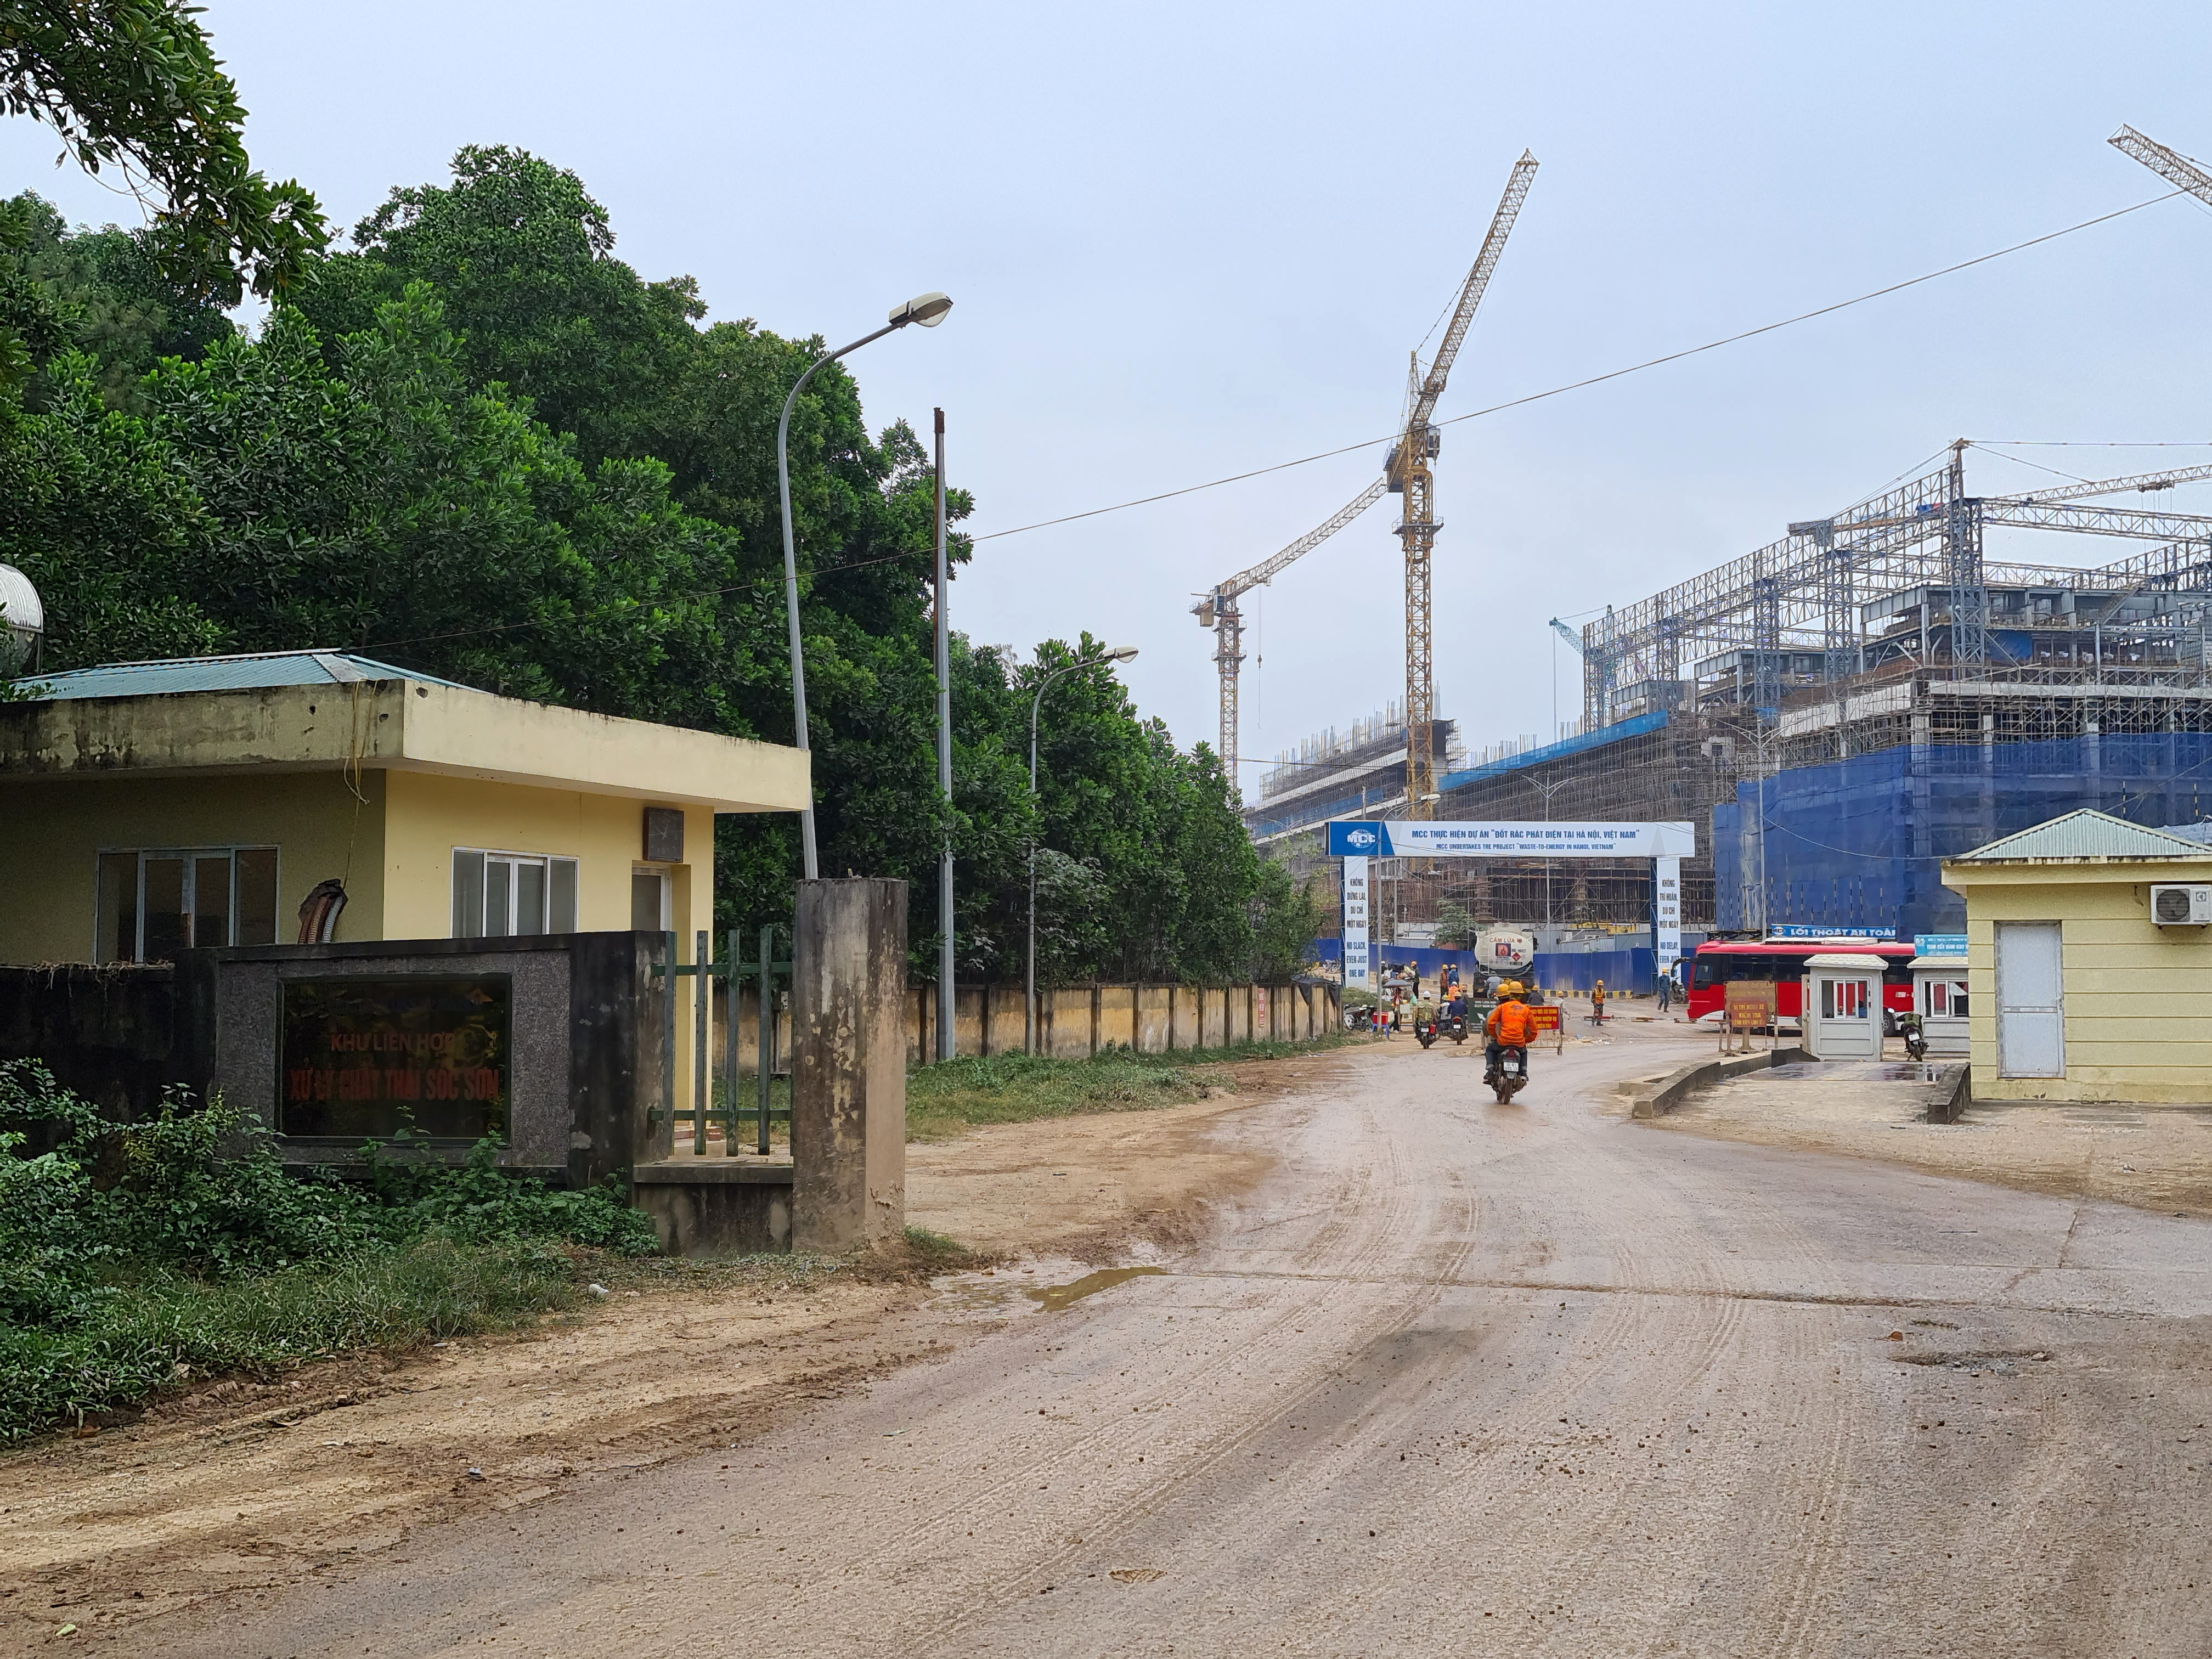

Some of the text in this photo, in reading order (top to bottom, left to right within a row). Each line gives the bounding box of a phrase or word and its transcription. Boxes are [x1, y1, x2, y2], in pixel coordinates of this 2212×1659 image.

[1347, 834, 1375, 843] MCC
[1430, 830, 1448, 839] THỰC
[1449, 829, 1466, 839] HIỆN
[1468, 830, 1478, 839] DỰ
[1480, 830, 1489, 838] ÁN
[1510, 830, 1524, 838] RÁC
[1526, 830, 1543, 838] PHÁT
[1545, 830, 1562, 840] ĐIỆN
[1564, 831, 1574, 840] TẠI
[1576, 830, 1585, 838] HÀ
[1587, 830, 1601, 840] NỘI,
[1603, 830, 1618, 840] VIỆT
[1350, 877, 1363, 887] KHÔNG
[1662, 878, 1675, 887] KHÔNG
[1347, 890, 1358, 900] DỪNG
[1350, 905, 1356, 914] DÙ
[1662, 905, 1668, 915] DÙ
[1347, 918, 1367, 930] MỘT NGÀY
[1659, 918, 1679, 930] MỘT NGÀY
[1791, 927, 1808, 935] LỐI
[1353, 942, 1366, 950] SLACK,
[1667, 942, 1678, 950] DELAY,
[1349, 969, 1357, 978] ONE
